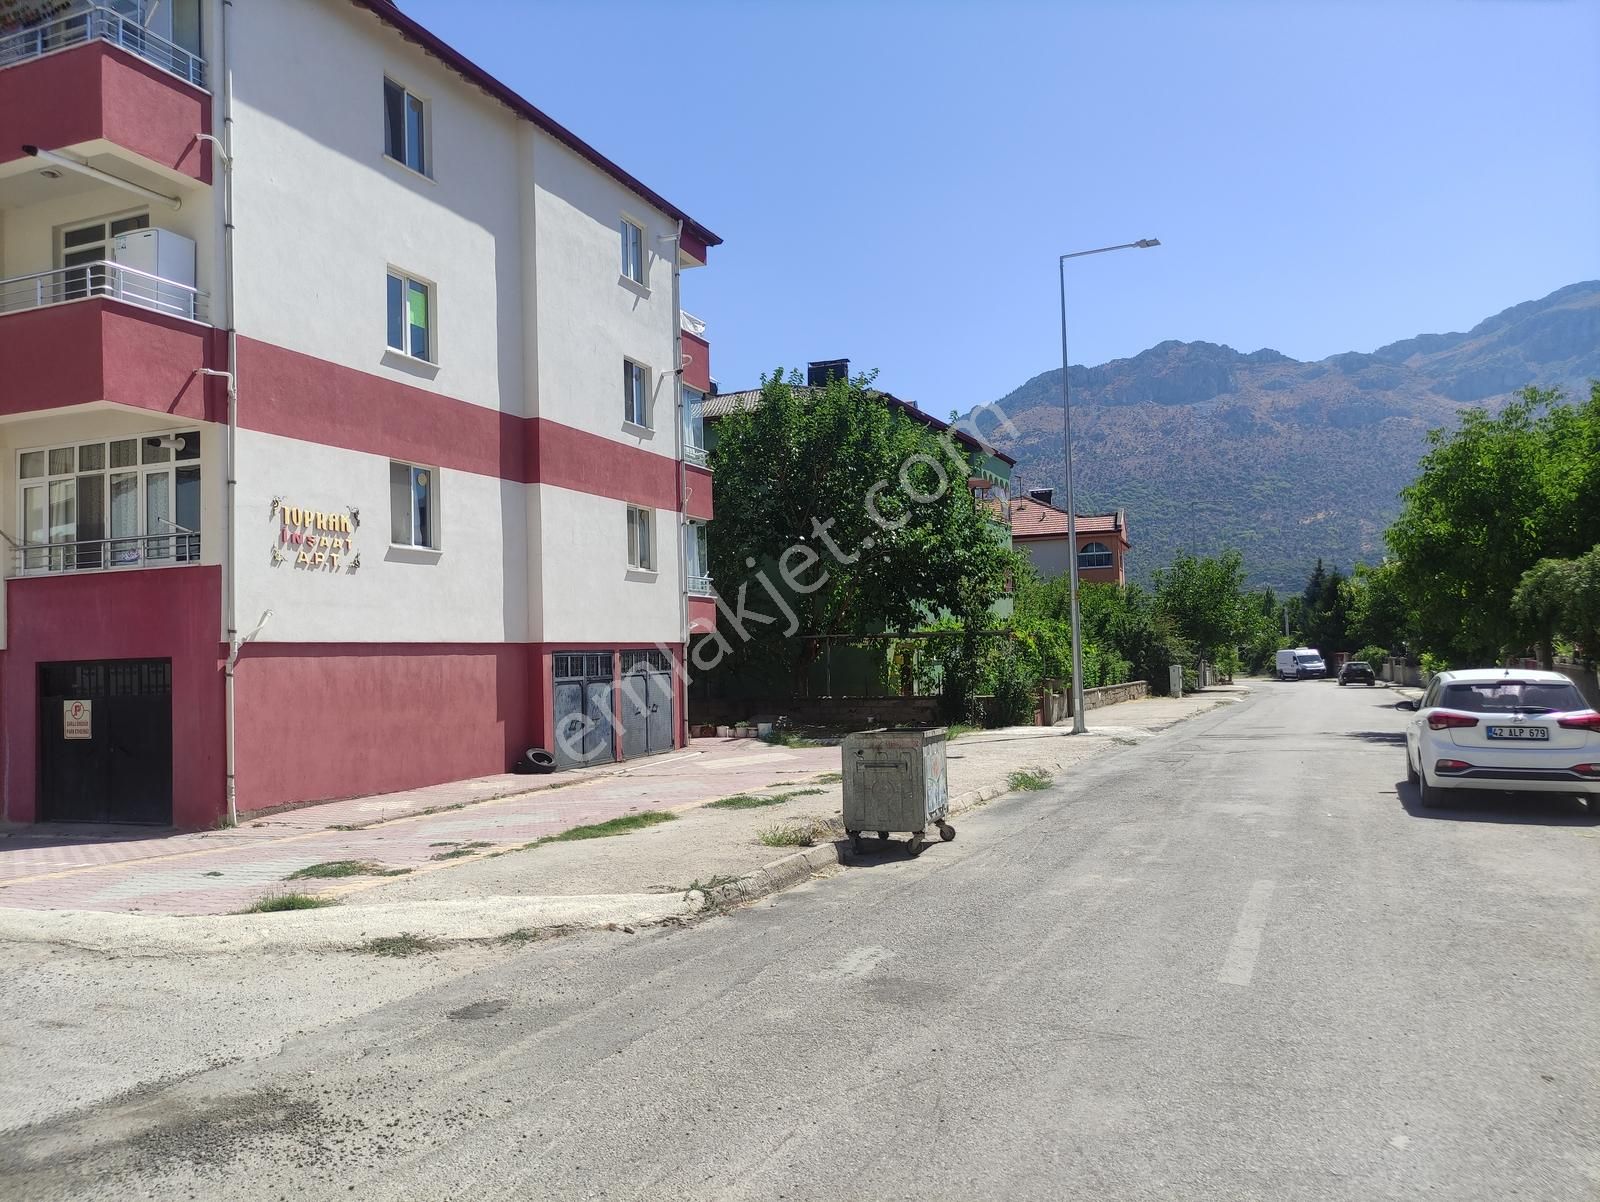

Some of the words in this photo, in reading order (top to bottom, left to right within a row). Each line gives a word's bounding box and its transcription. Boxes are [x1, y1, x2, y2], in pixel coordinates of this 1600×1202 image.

[1493, 728, 1503, 737] 42
[1509, 728, 1524, 737] ALP
[1529, 728, 1545, 738] 679
